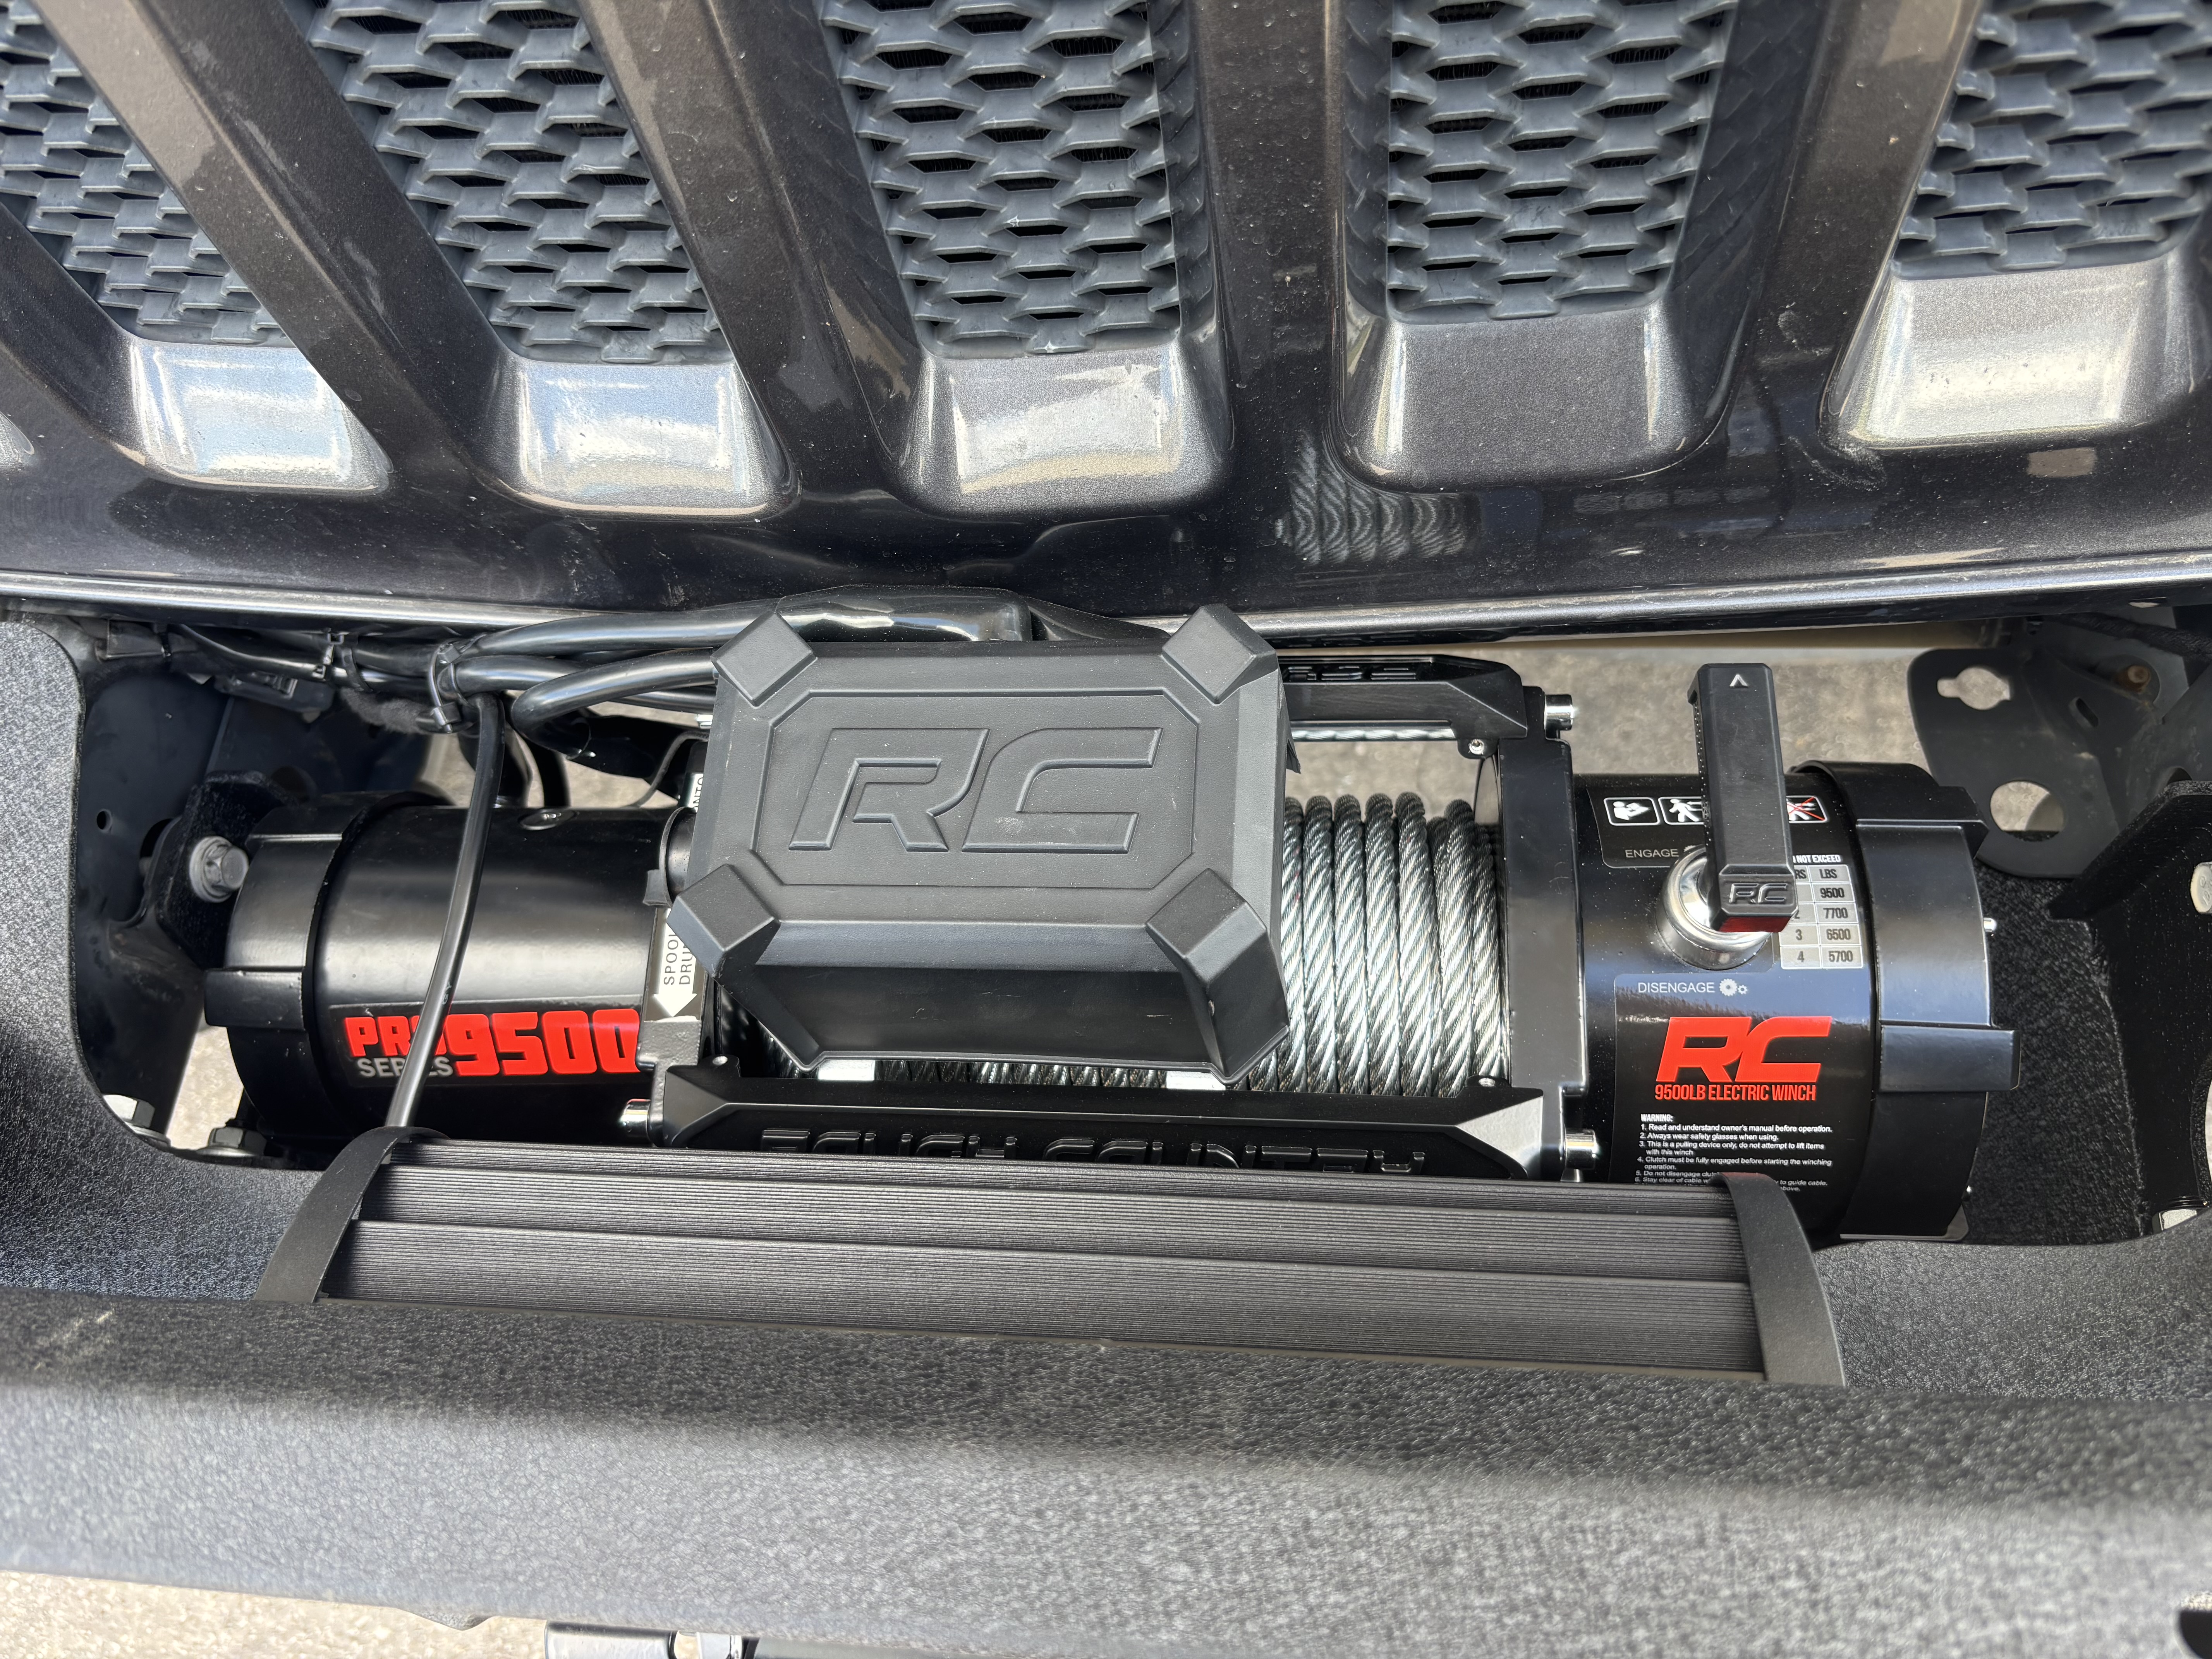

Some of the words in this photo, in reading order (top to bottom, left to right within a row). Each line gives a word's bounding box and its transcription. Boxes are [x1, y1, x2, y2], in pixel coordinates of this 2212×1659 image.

[788, 727, 1163, 854] RC
[1625, 848, 1679, 858] ENGAGE
[1796, 855, 1812, 863] NOT
[1812, 854, 1841, 863] EXCEED
[1819, 868, 1837, 878] LBS
[1729, 883, 1788, 904] RC
[1820, 888, 1844, 898] 9500
[1823, 907, 1848, 919] 7700
[1795, 929, 1802, 941] 3
[1826, 928, 1851, 940] 6500
[1797, 951, 1805, 962] 4
[1828, 950, 1853, 962] 5700
[679, 945, 692, 985] DRU
[1638, 982, 1715, 993] DISENGAGE
[446, 1008, 641, 1076] 9500
[1656, 1016, 1832, 1082] RC
[357, 1057, 453, 1078] SERS
[1655, 1084, 1705, 1100] 9500LB
[1708, 1084, 1769, 1101] ELECTRIC
[1772, 1084, 1816, 1101] WINCH
[1641, 1114, 1674, 1122] WARNING:
[1798, 1125, 1832, 1134] operation.
